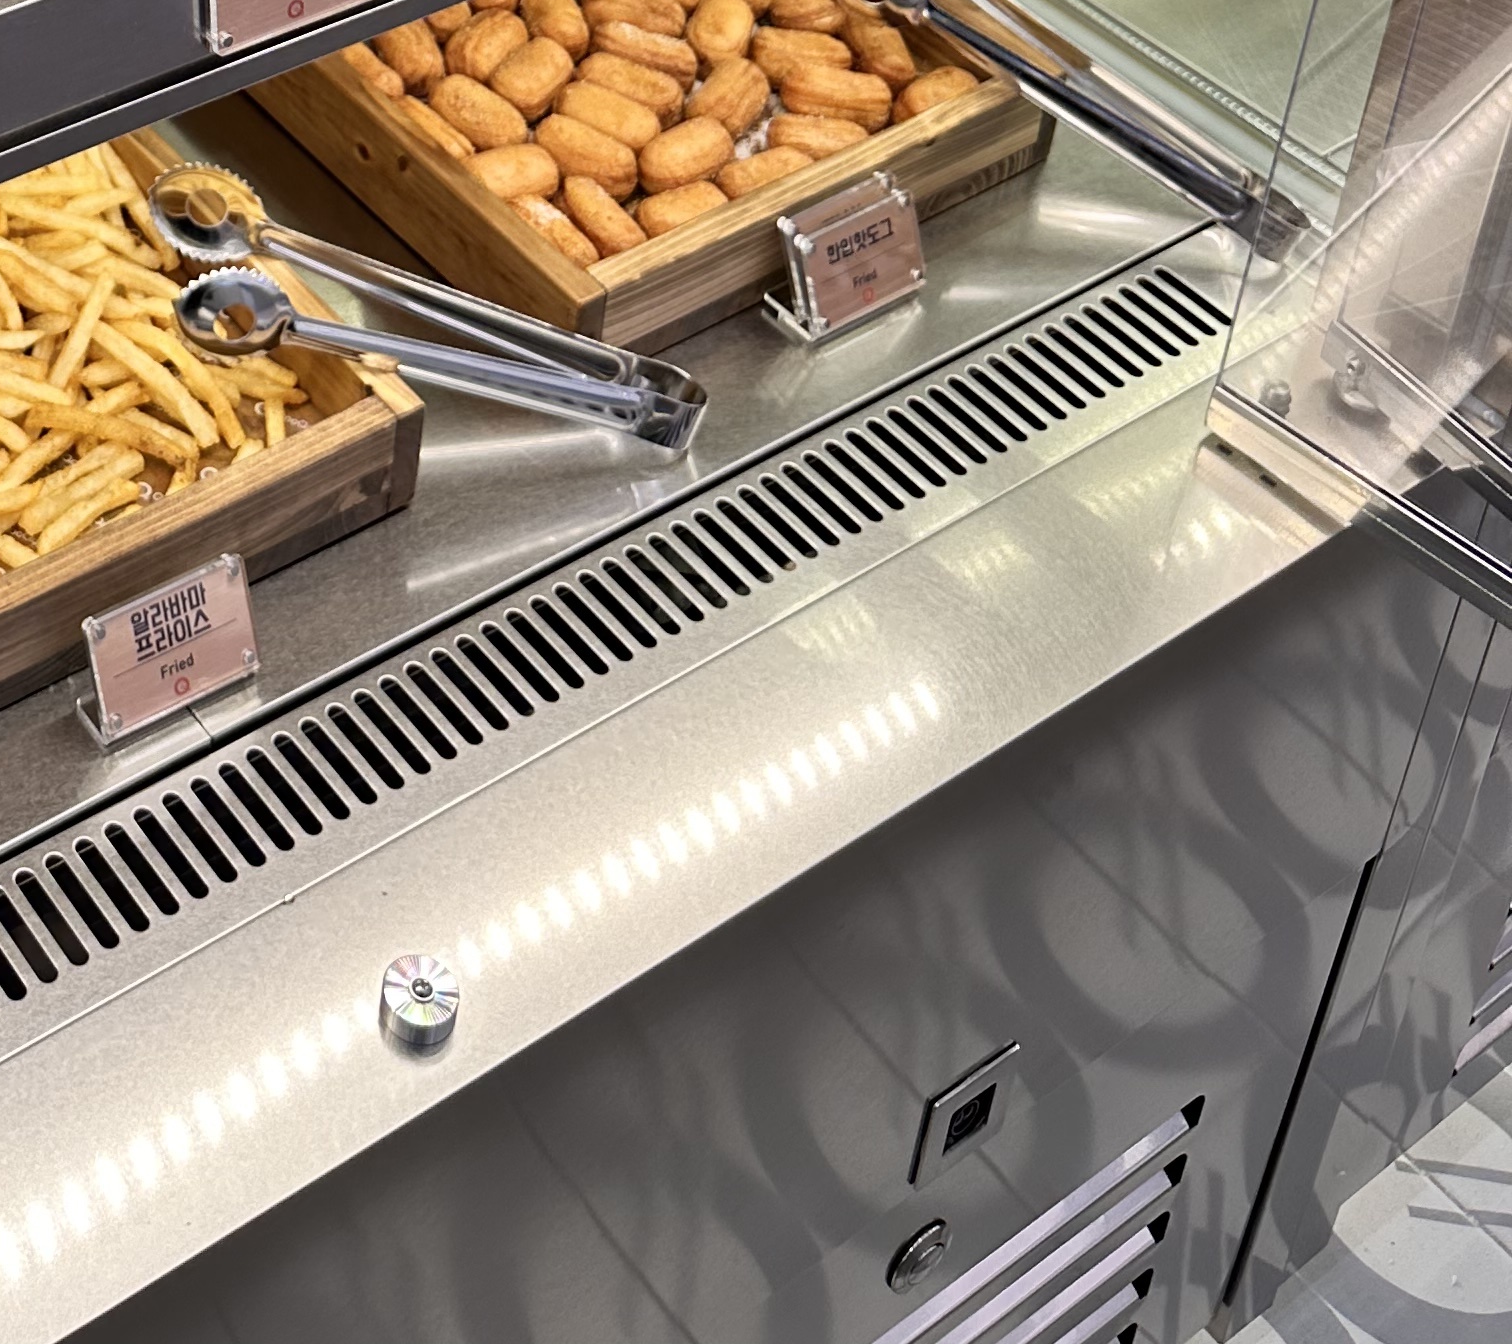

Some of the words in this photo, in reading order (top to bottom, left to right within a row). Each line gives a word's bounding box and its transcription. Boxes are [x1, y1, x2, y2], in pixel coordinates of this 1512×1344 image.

[826, 216, 895, 265] 한입핫도그
[852, 267, 878, 289] Fried
[130, 581, 207, 637] 알라바마
[134, 608, 212, 662] 프라이스
[159, 652, 195, 680] Fried
